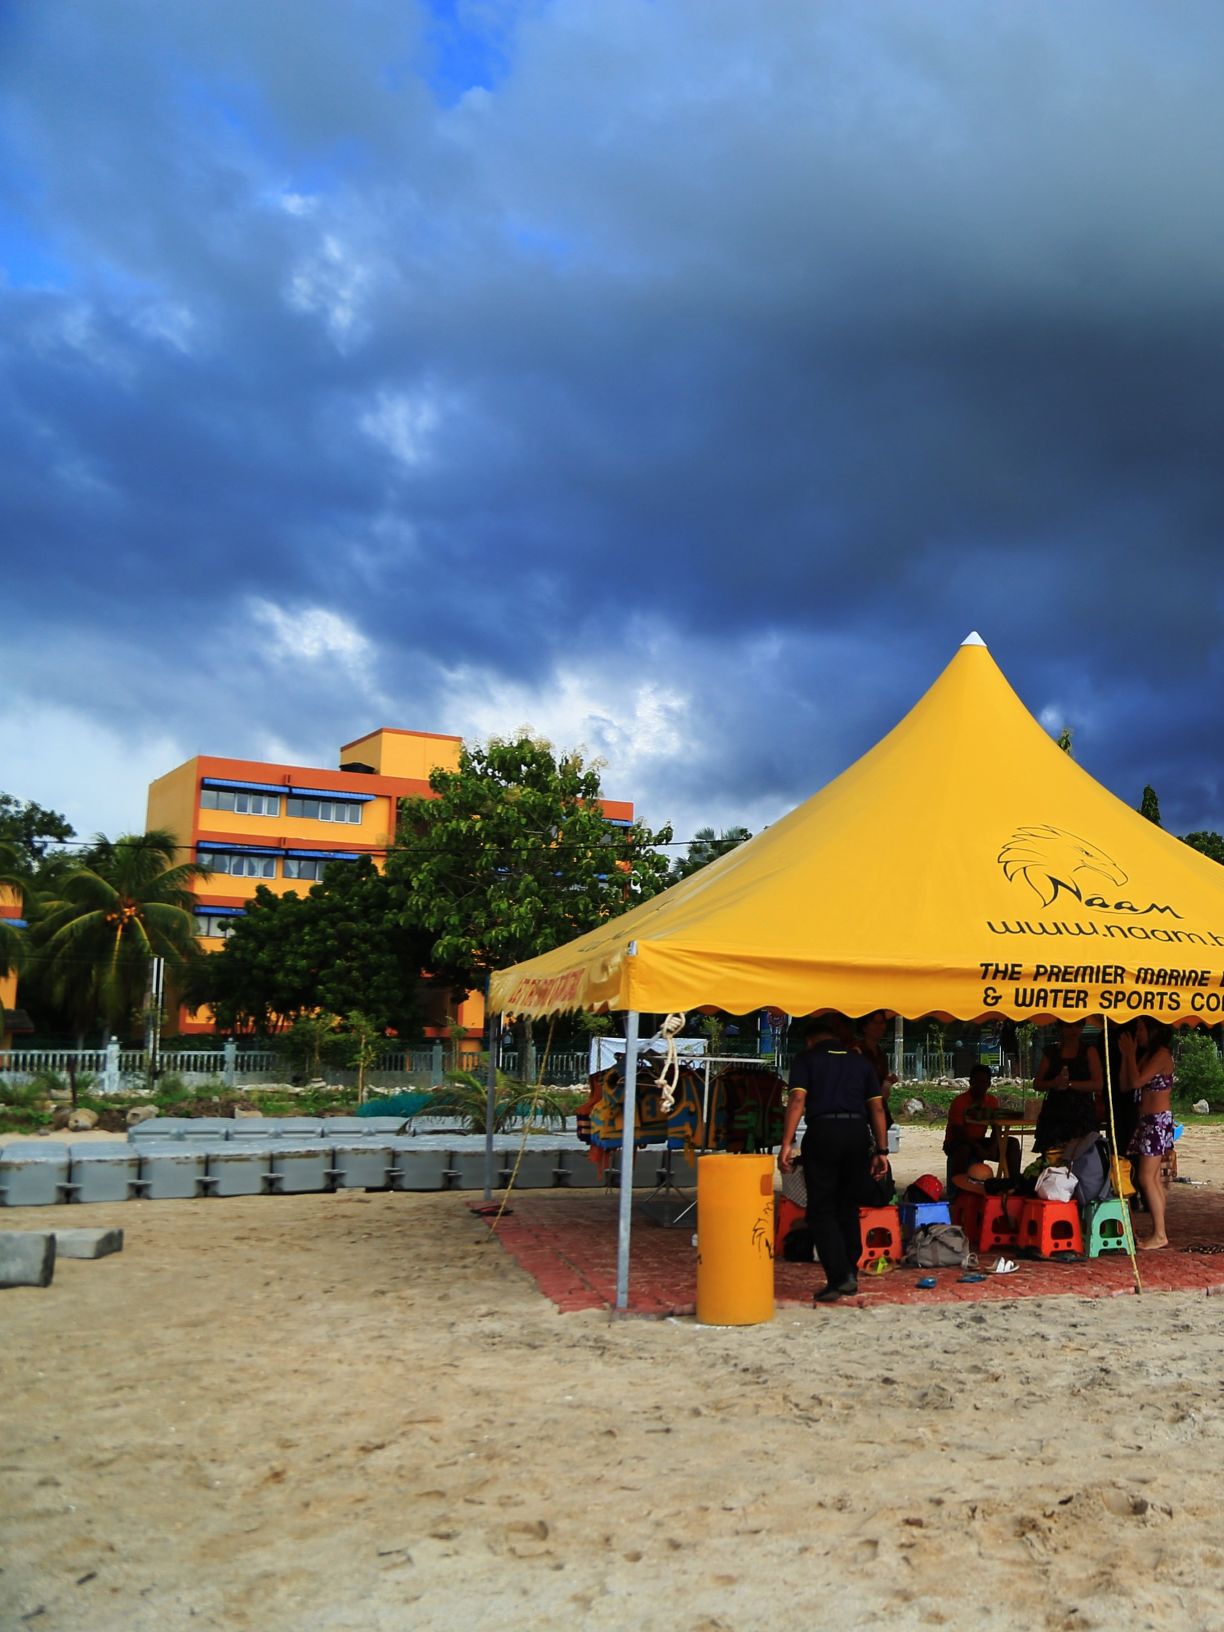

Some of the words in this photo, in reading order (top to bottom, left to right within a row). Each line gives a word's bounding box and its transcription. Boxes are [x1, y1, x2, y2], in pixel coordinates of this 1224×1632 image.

[980, 962, 1023, 981] THE
[1032, 964, 1126, 985] PREMIER
[1134, 967, 1212, 987] MARINE
[982, 986, 1003, 1007] &
[1013, 987, 1090, 1009] WATER
[1098, 990, 1181, 1011] SPORTS
